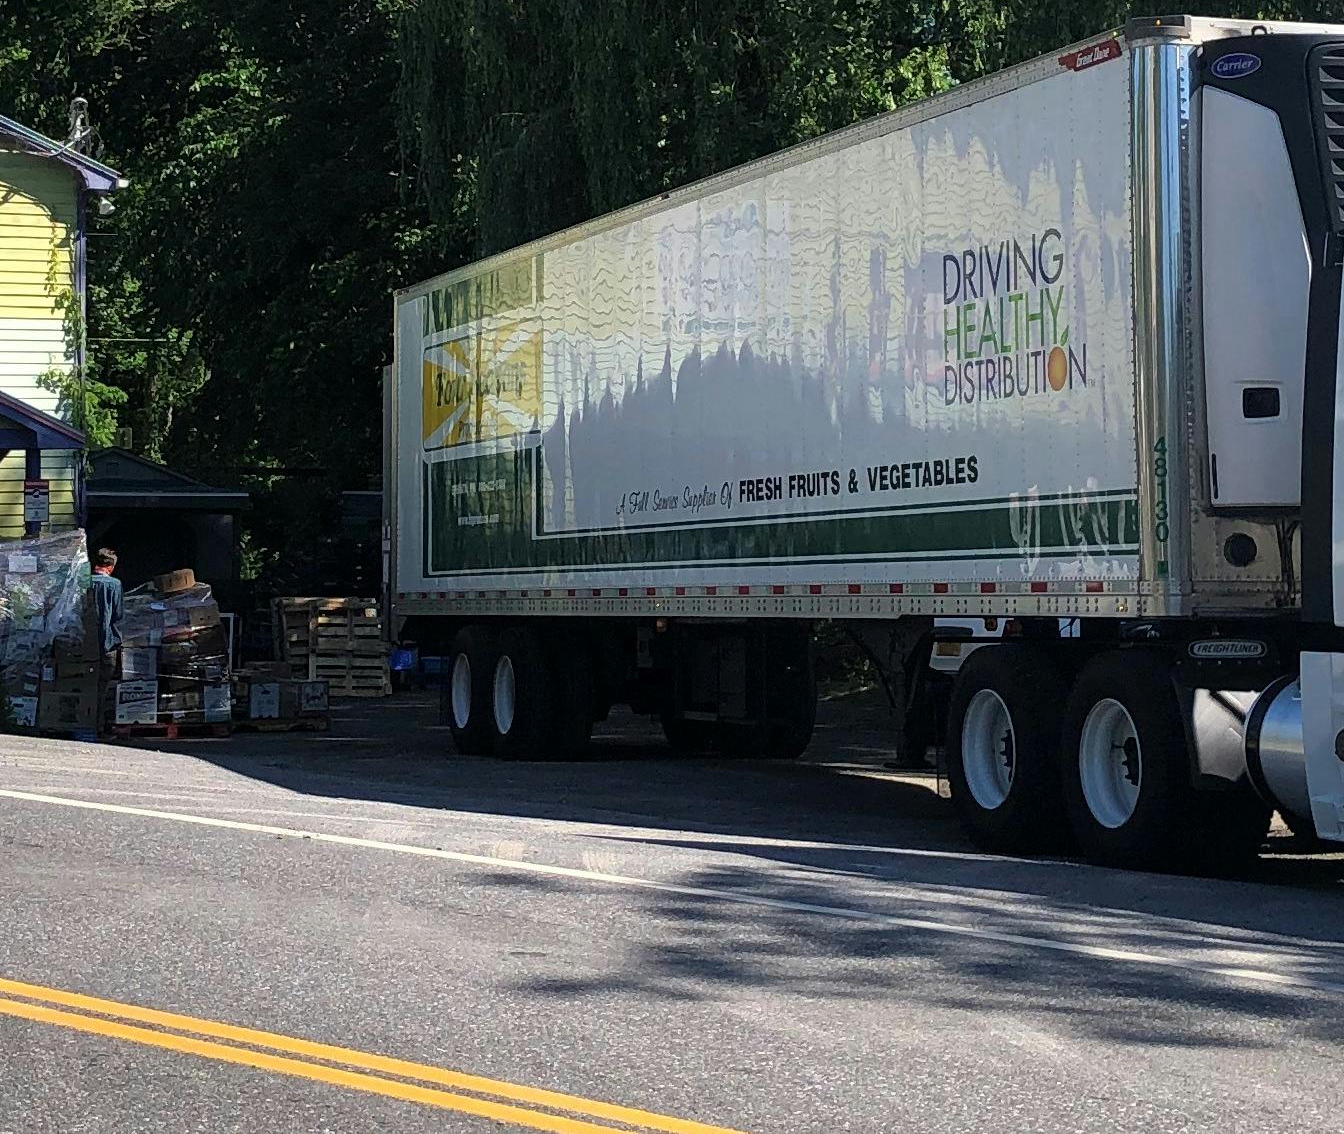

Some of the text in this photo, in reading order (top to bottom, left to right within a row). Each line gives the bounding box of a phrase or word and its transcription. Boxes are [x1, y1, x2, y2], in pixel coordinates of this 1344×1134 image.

[1217, 59, 1254, 72] Carrier
[943, 228, 1064, 305] DRIVING
[943, 285, 1065, 362] HEALTHY
[944, 342, 1088, 406] DISTRIBUTION
[720, 481, 734, 509] Of
[739, 476, 782, 503] FRESH
[788, 470, 841, 499] FRUITS
[847, 468, 859, 494] &
[867, 455, 979, 491] VEGETABLES
